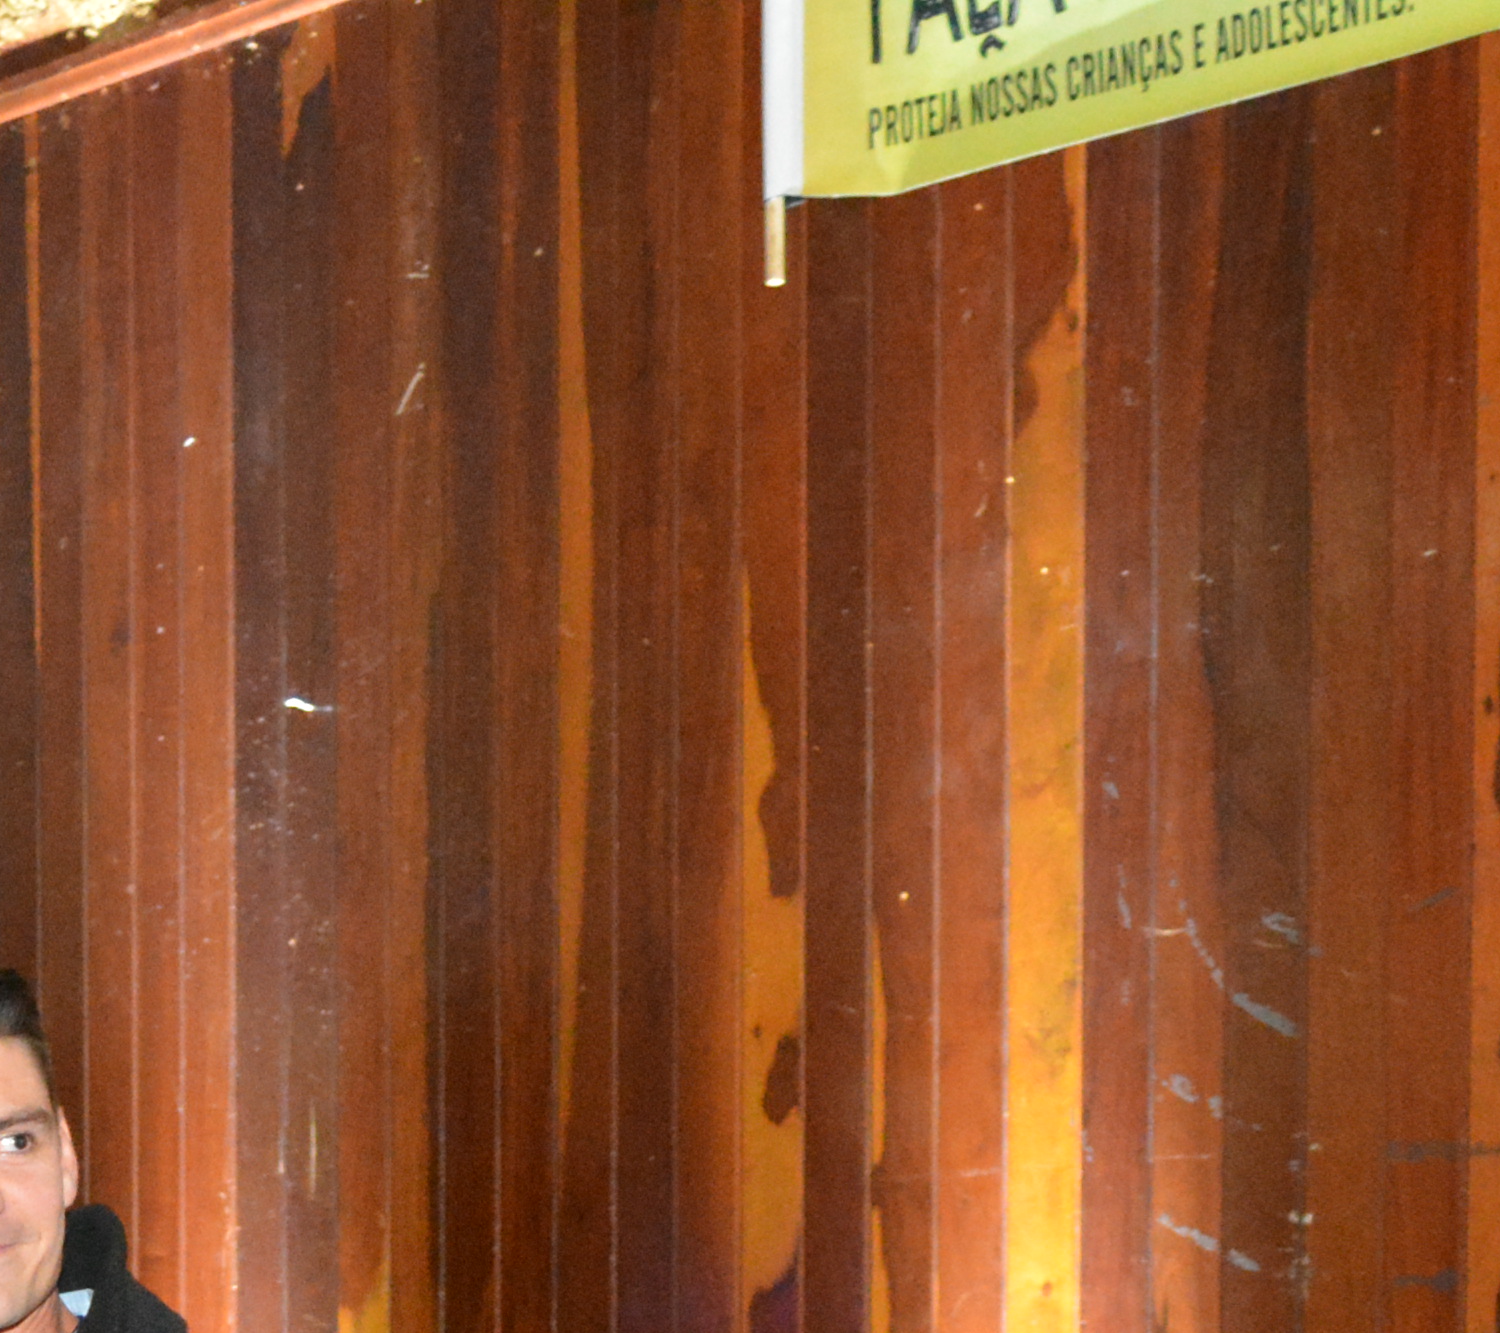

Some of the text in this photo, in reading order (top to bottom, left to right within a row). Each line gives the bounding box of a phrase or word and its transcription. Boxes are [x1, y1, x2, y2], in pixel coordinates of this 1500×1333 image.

[867, 89, 963, 150] PROTEJA
[970, 62, 1058, 126] NOSSAS
[1065, 29, 1183, 102] CRIANÇAS
[1193, 23, 1207, 69] E
